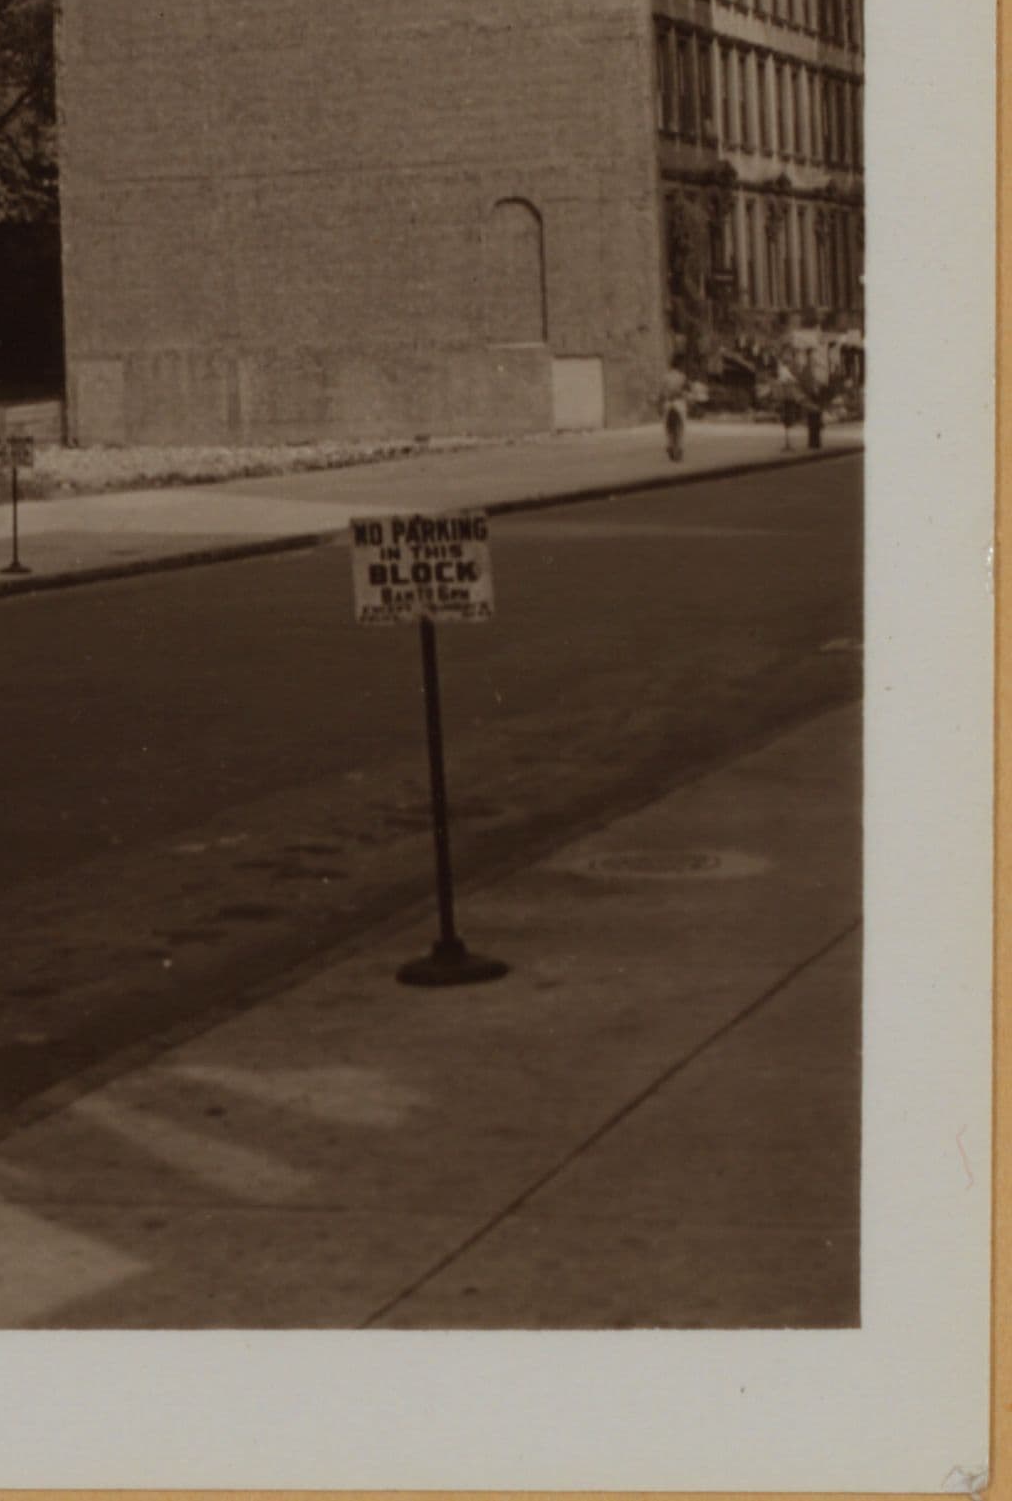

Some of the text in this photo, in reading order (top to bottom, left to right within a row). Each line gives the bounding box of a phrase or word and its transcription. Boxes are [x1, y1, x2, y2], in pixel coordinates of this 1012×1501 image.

[354, 515, 488, 548] NO PARKING
[380, 544, 463, 561] IN THIS
[369, 561, 479, 586] BLOCK
